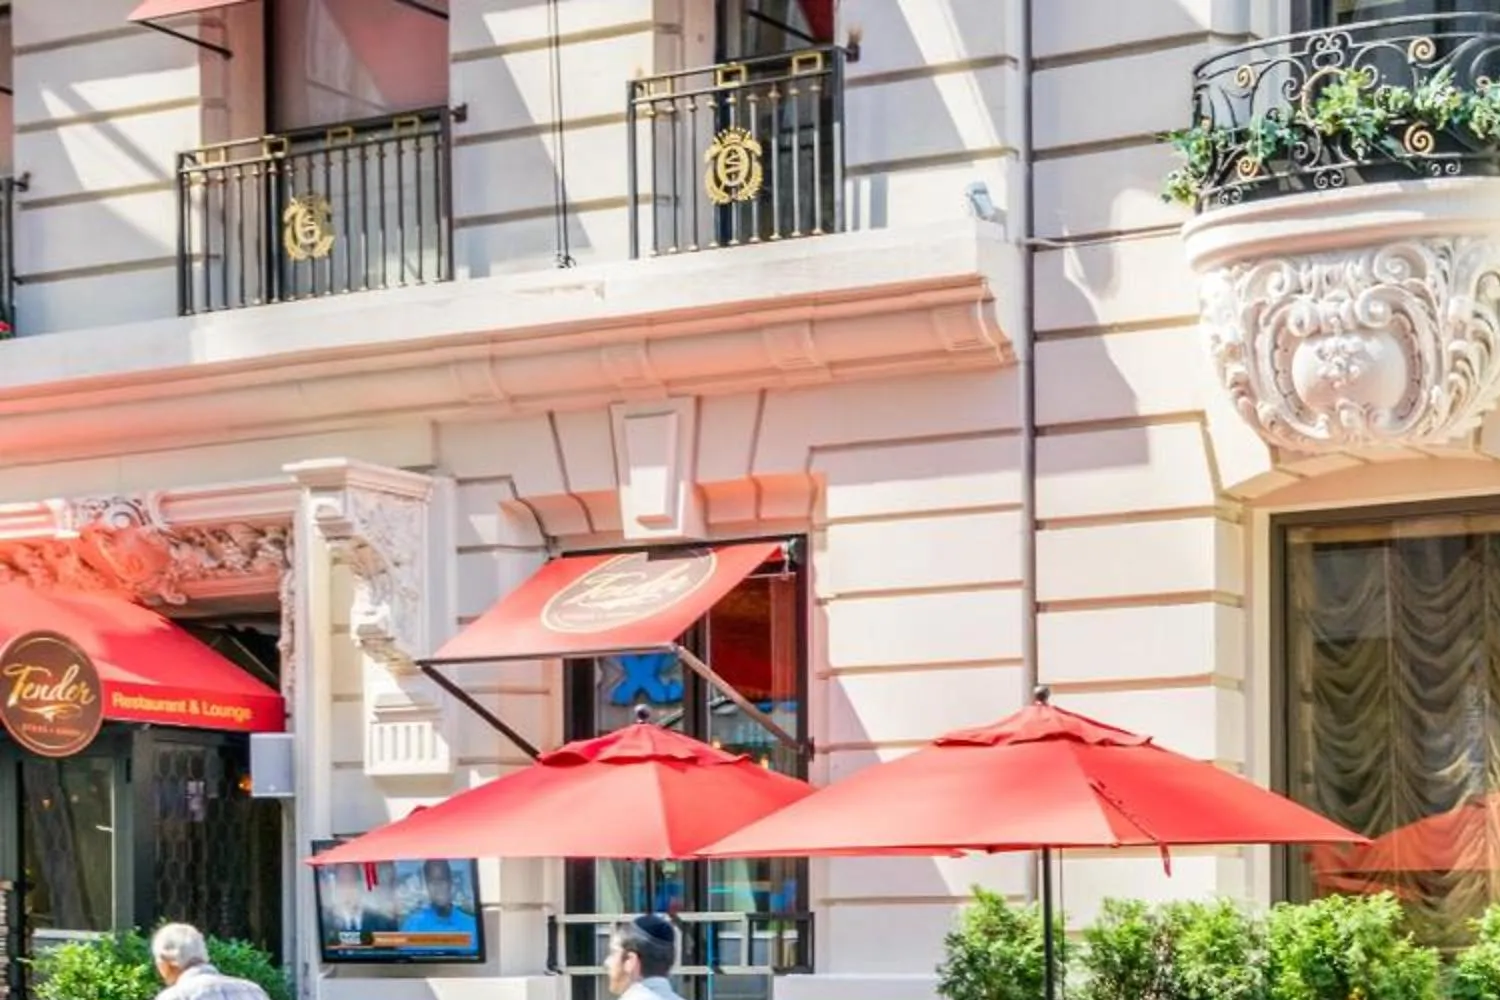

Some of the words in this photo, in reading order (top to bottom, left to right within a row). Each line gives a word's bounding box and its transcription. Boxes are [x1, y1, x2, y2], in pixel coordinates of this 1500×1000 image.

[3, 663, 97, 707] Tender
[111, 690, 187, 713] Restaurant
[189, 699, 200, 715] &
[202, 700, 251, 722] Lounge
